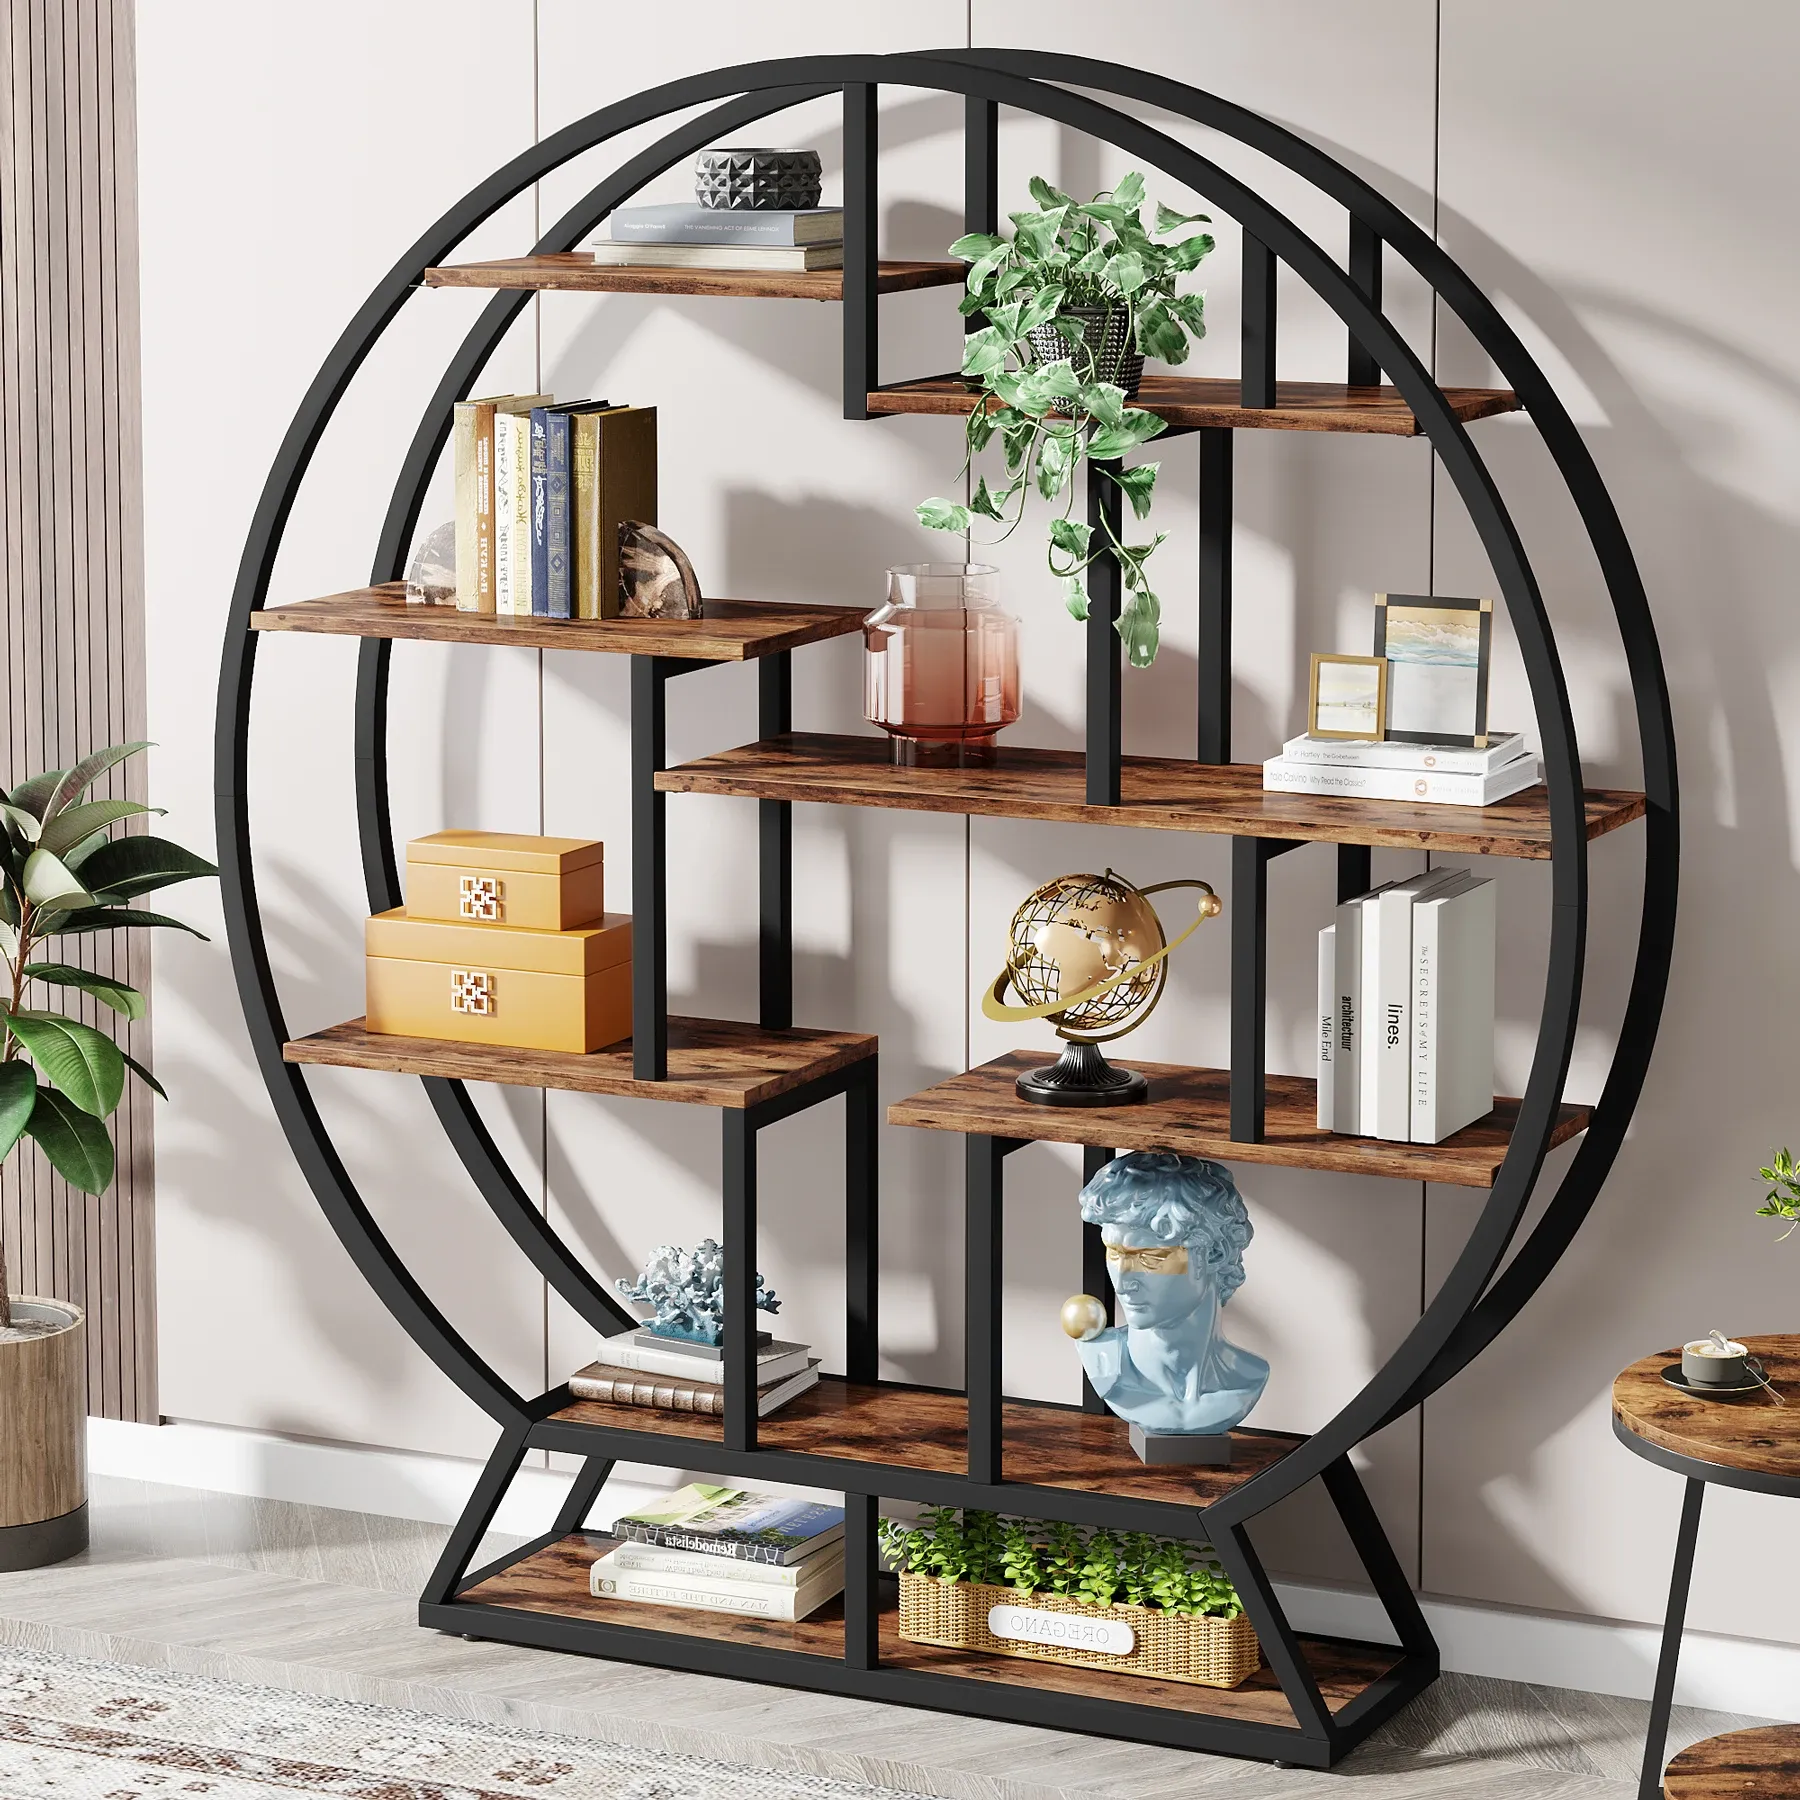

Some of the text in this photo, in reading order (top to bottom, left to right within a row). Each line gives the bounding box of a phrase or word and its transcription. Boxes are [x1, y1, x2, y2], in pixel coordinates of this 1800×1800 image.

[1284, 771, 1308, 784] Calvino
[1309, 775, 1366, 789] Why Read the Classics?
[1421, 945, 1429, 956] The
[1419, 958, 1429, 1028] SECRETS
[1321, 1015, 1332, 1062] Mile End
[1341, 995, 1355, 1052] architectuur
[1387, 1003, 1403, 1050] lines.
[1418, 1039, 1428, 1061] MY
[1418, 1071, 1427, 1106] LIFE
